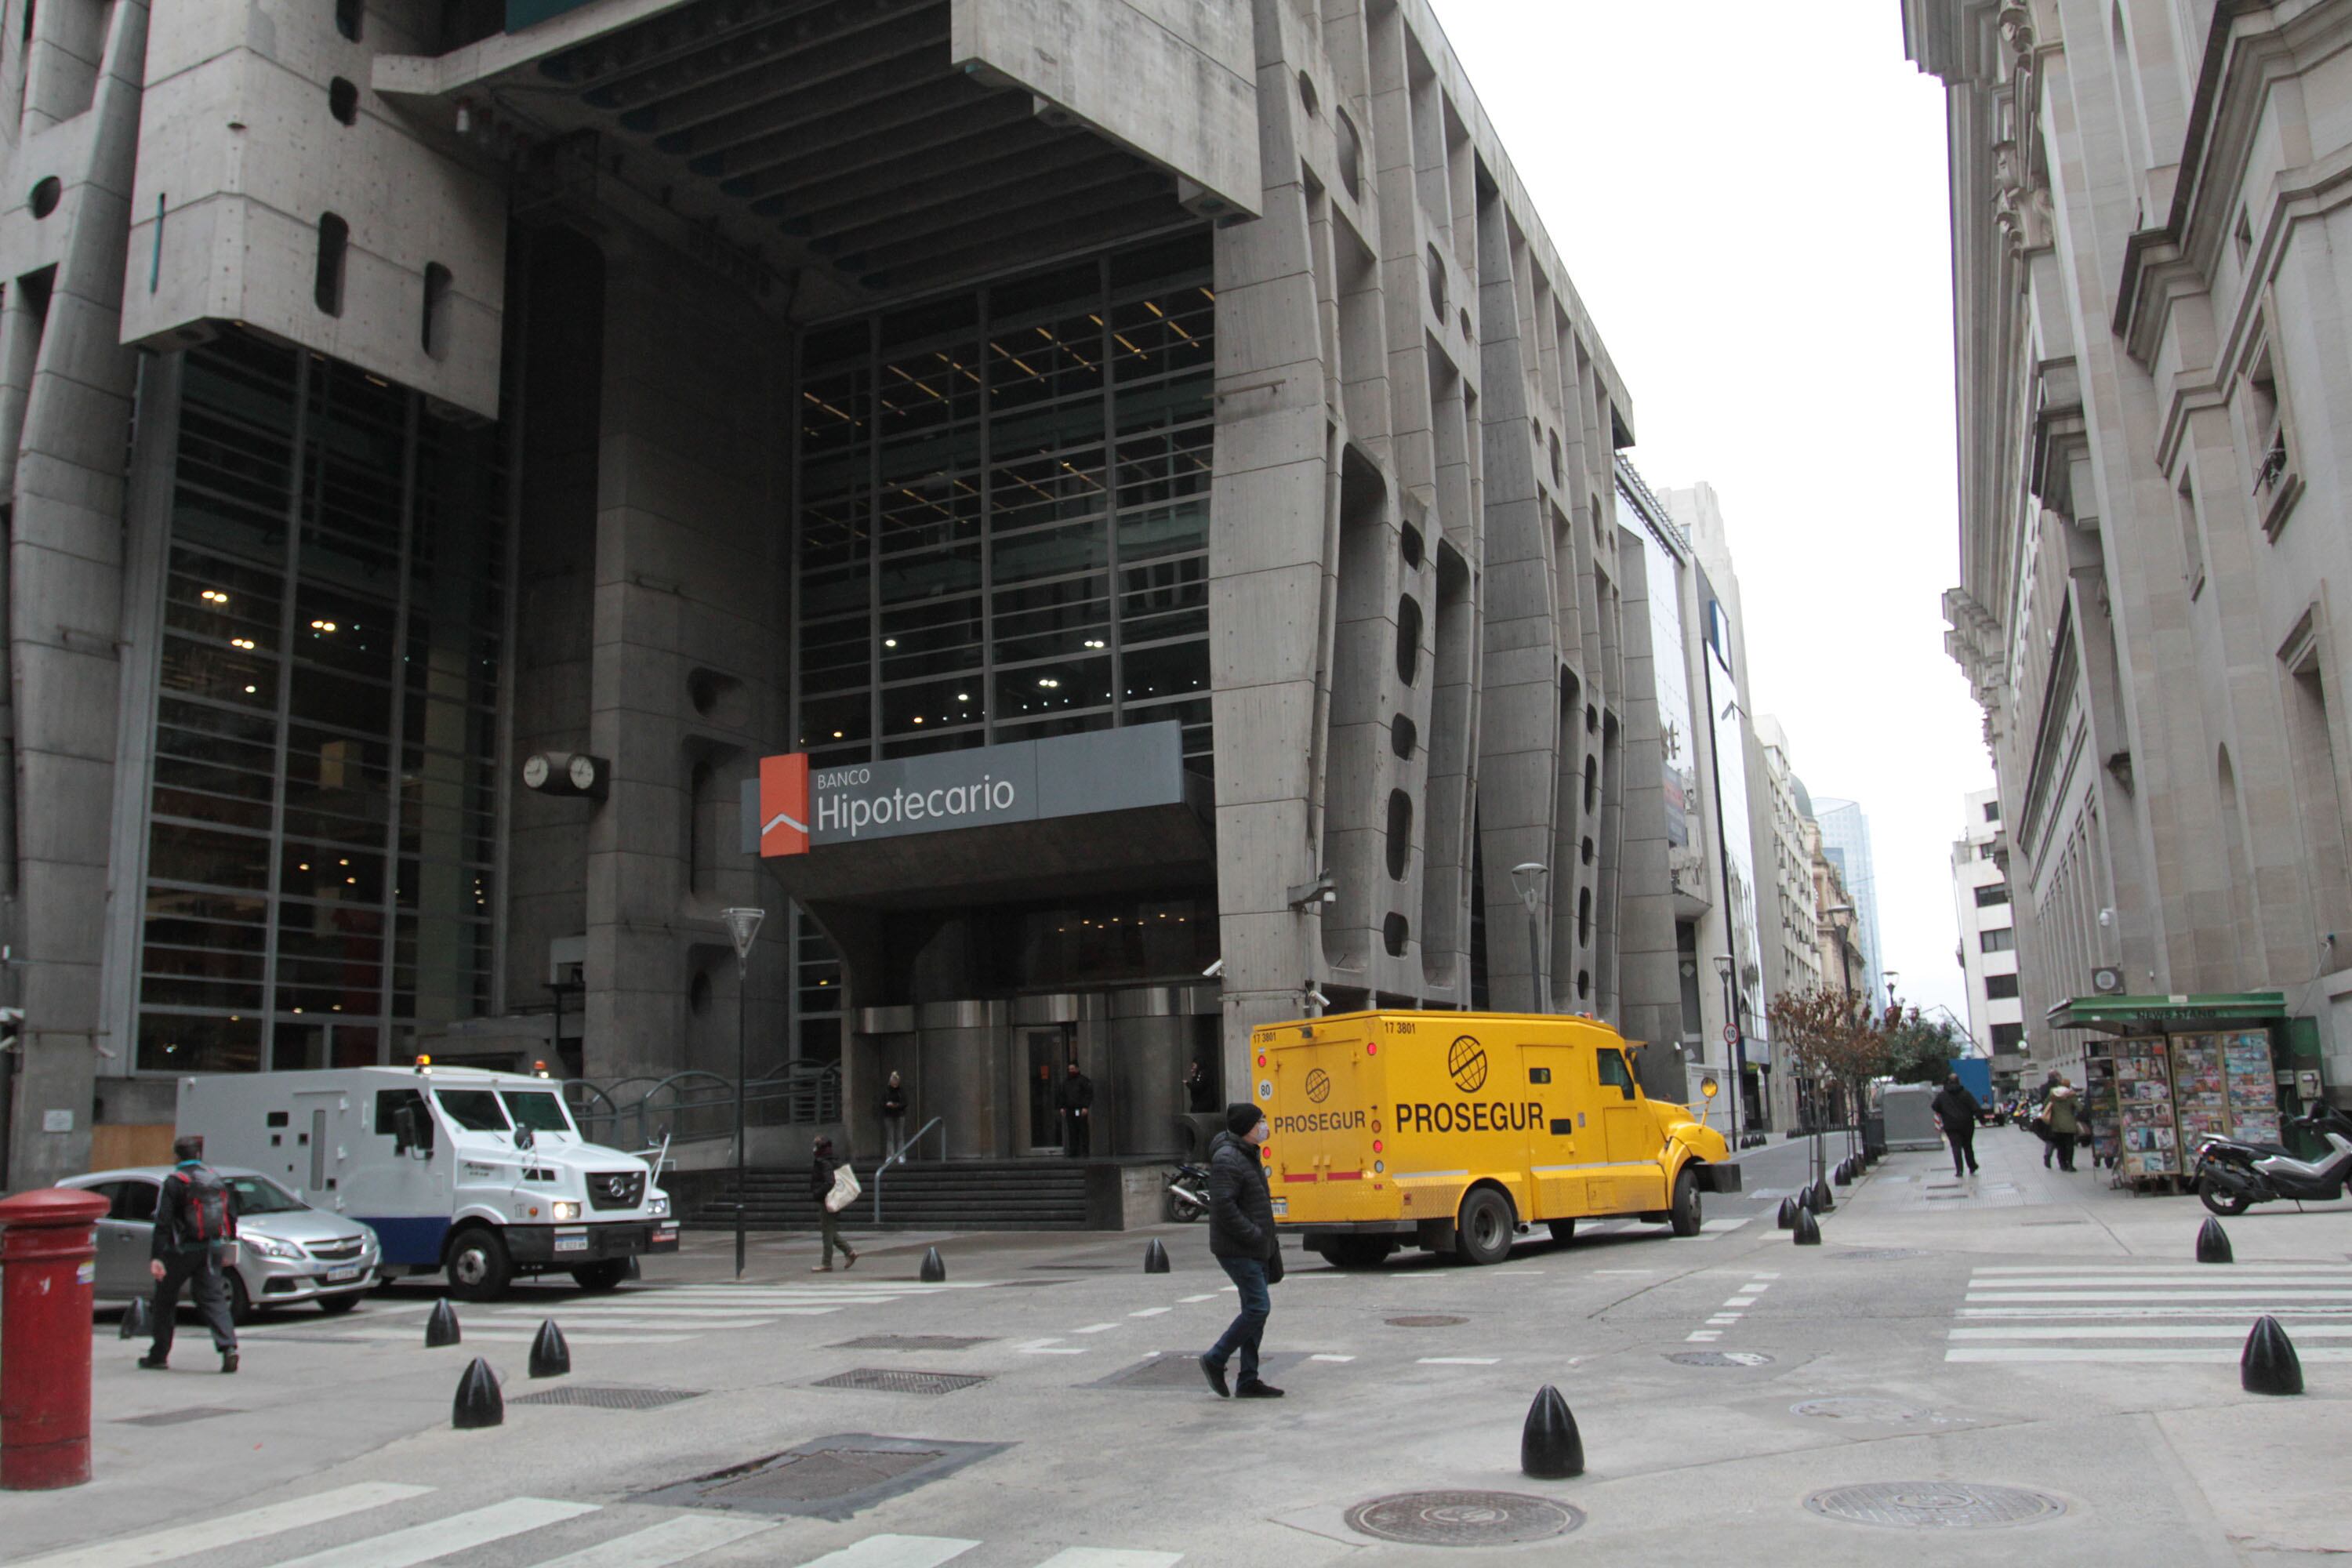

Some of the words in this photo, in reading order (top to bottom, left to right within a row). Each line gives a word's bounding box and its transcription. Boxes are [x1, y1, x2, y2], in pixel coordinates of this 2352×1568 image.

[818, 768, 870, 789] BANCO
[818, 775, 1015, 837] Hipotecario
[2137, 1009, 2172, 1019] NEWS
[2176, 1008, 2216, 1018] STAND
[1385, 1022, 1394, 1033] 17
[1397, 1022, 1416, 1034] 3801
[1726, 1029, 1736, 1039] 10
[1254, 1034, 1261, 1044] 17
[1262, 1032, 1276, 1043] 3801
[1261, 1084, 1271, 1096] 80
[1275, 1110, 1366, 1134] PROSEGUR
[1396, 1102, 1544, 1134] PROSEGUR
